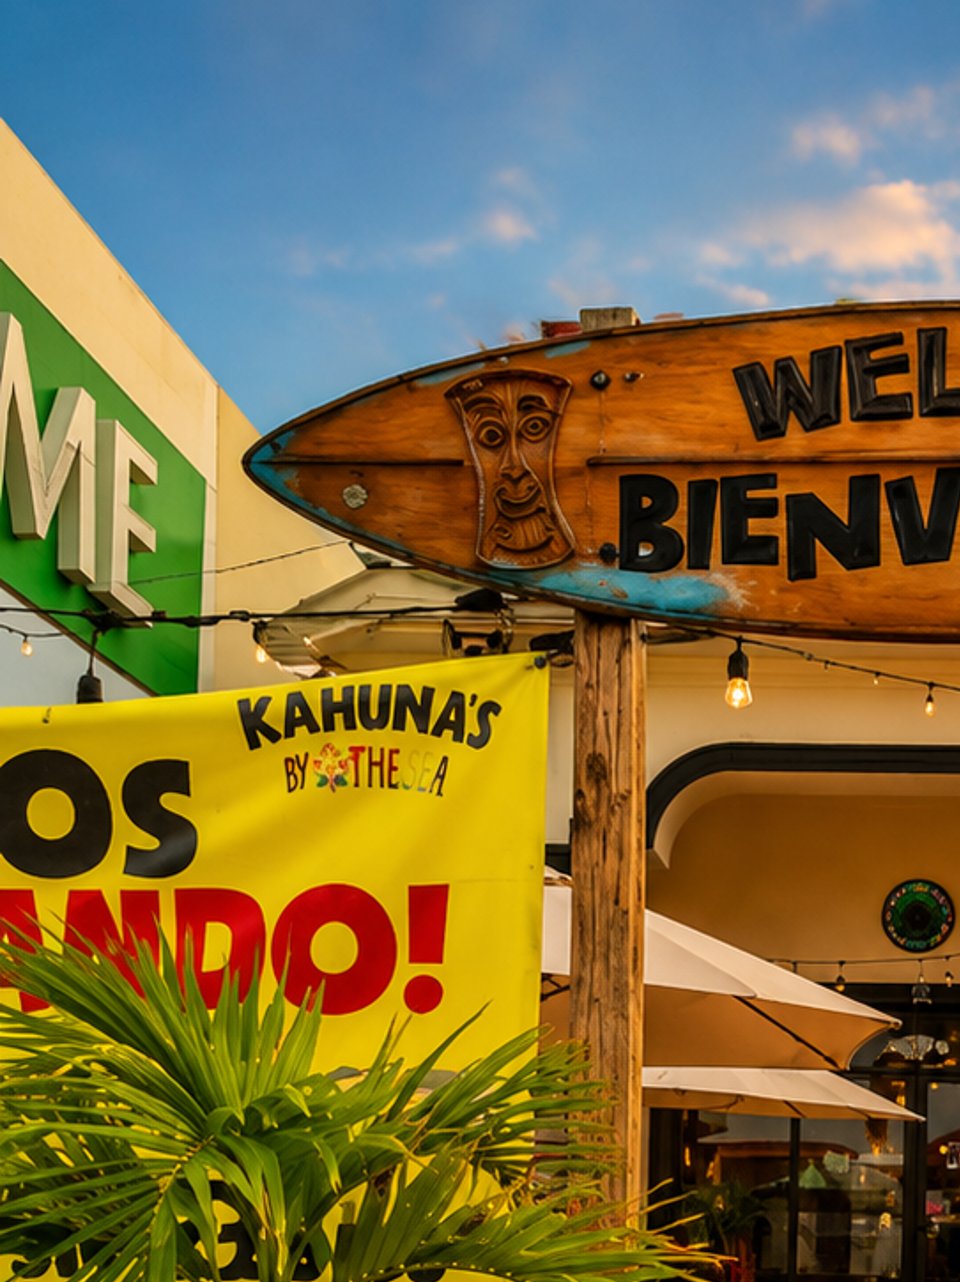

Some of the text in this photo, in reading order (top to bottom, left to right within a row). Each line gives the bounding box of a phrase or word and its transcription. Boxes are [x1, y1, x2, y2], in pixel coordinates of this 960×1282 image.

[237, 683, 502, 750] KAHUNA'S
[284, 751, 309, 793] BY
[348, 745, 400, 789] THE
[0, 748, 198, 879] OS
